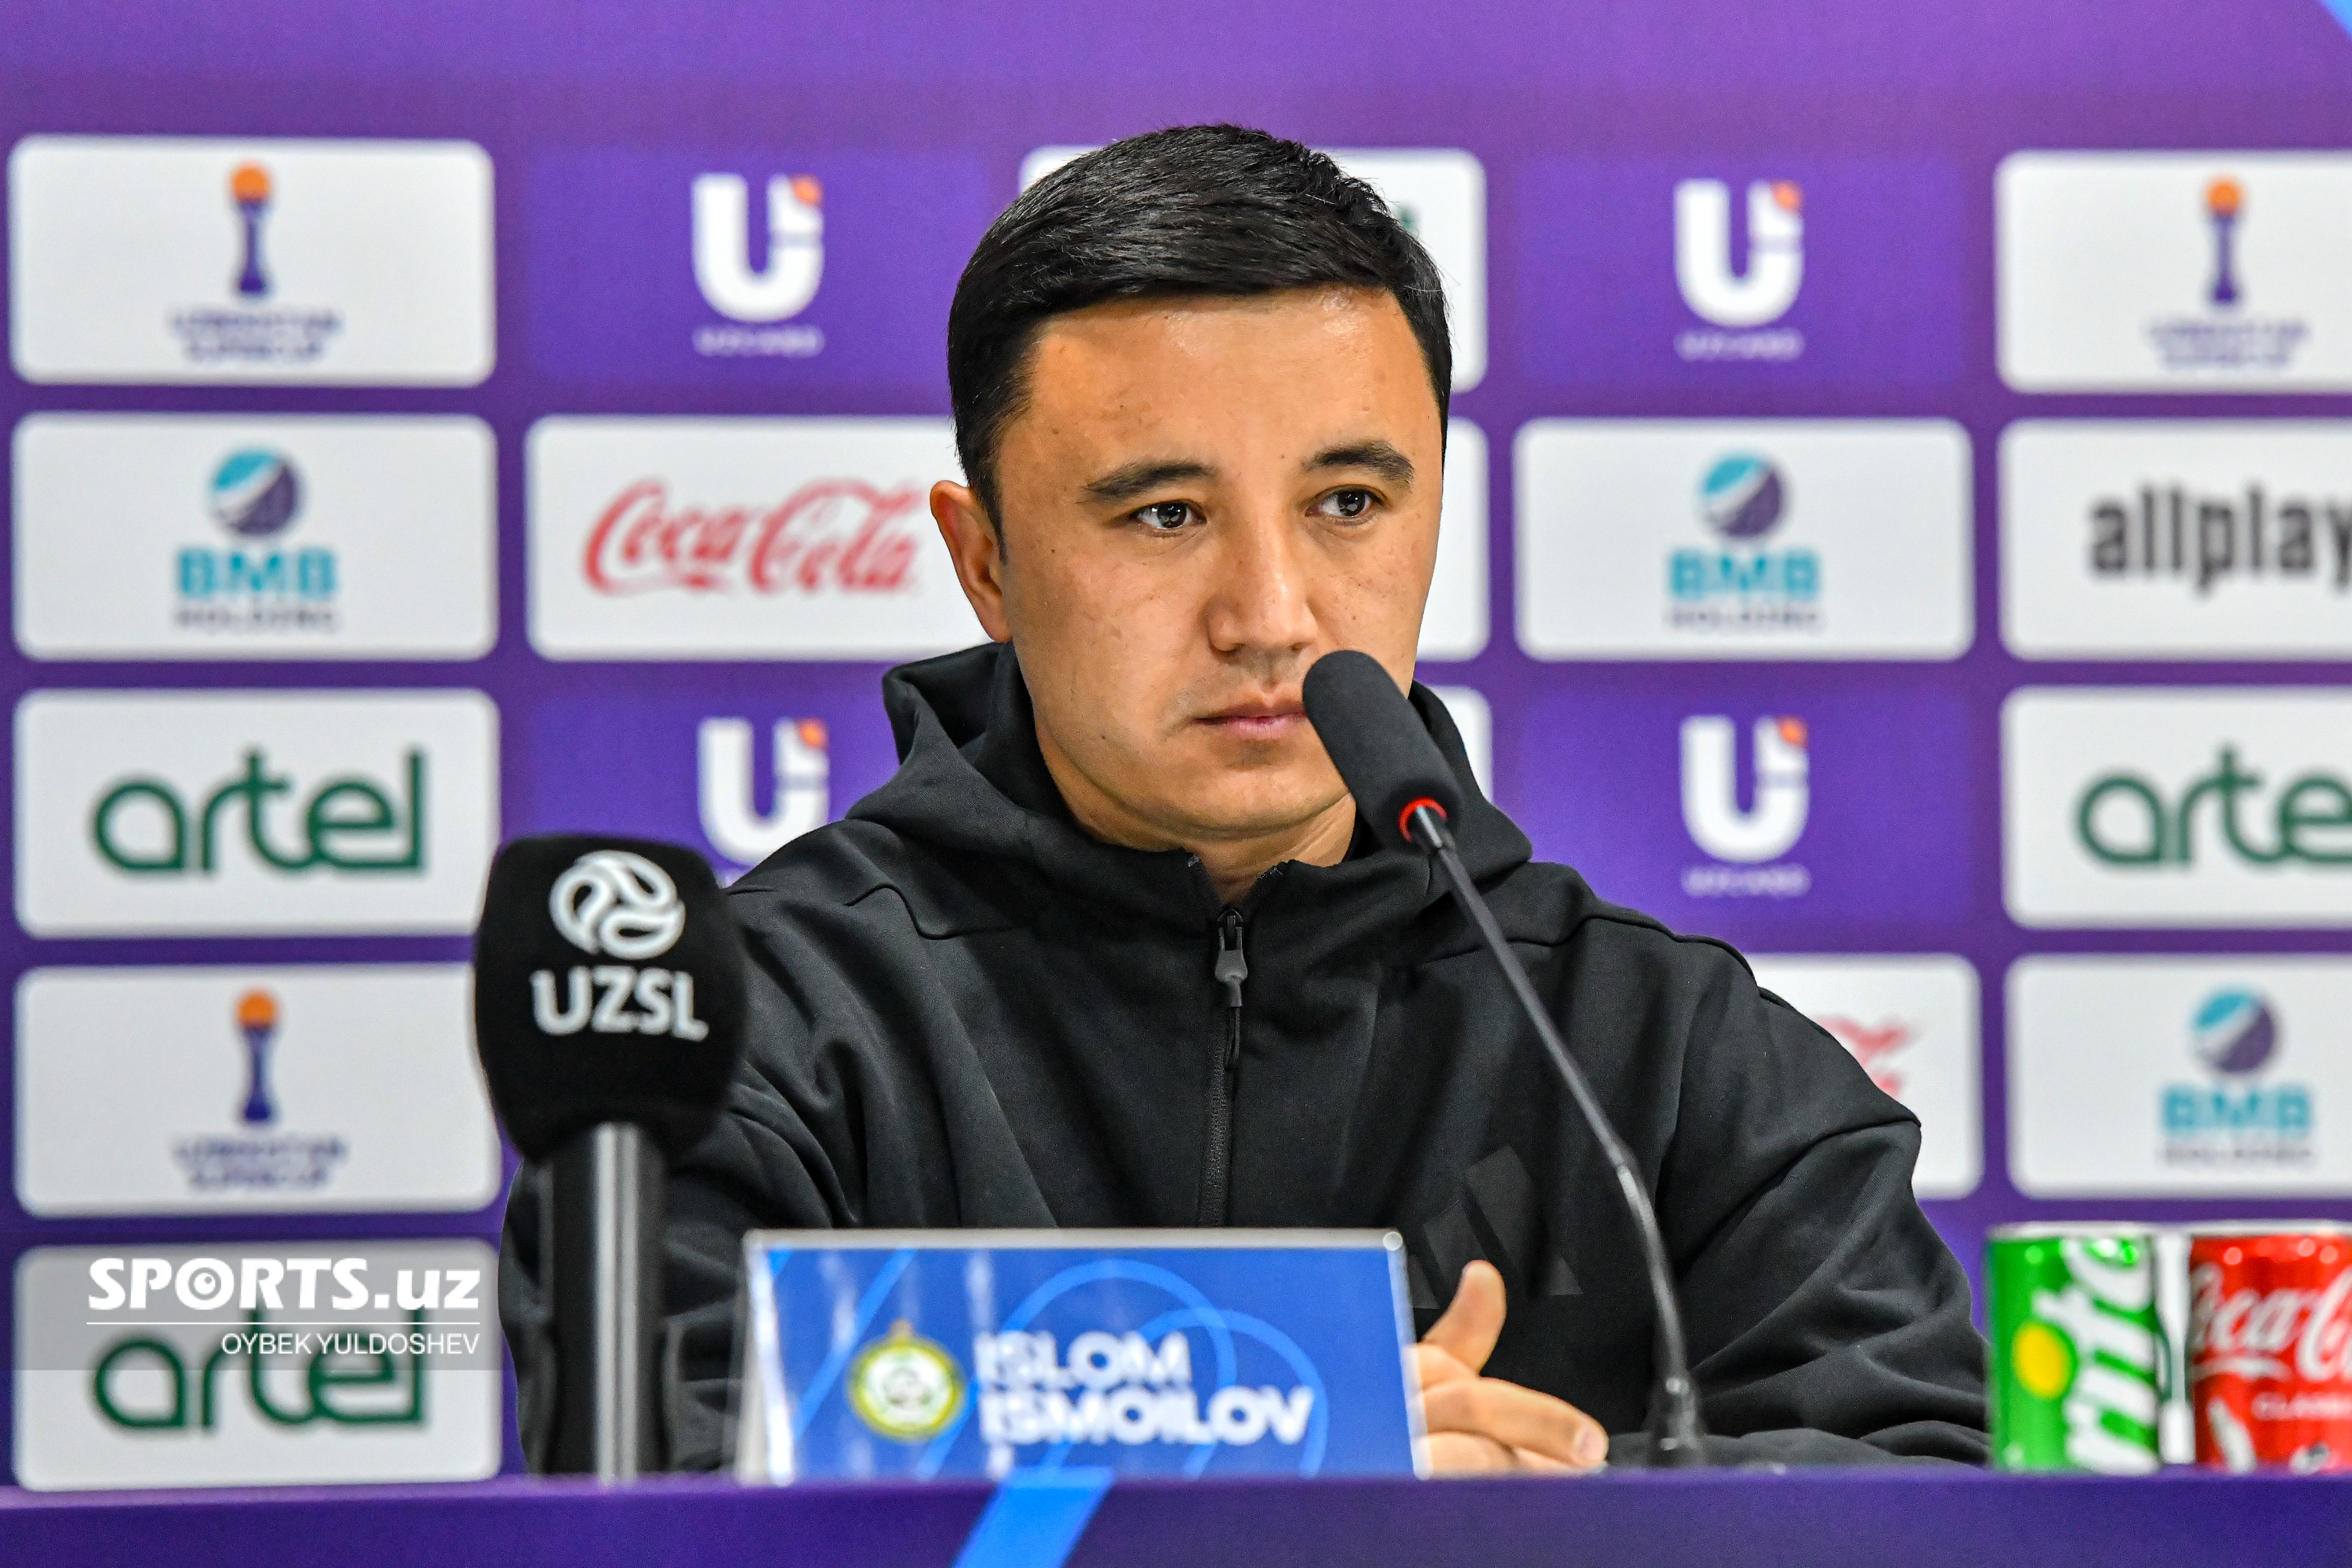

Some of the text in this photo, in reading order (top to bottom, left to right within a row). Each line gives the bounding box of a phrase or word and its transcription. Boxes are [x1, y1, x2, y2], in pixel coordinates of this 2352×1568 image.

[176, 546, 338, 598] BMB
[92, 746, 426, 874] artel
[529, 965, 709, 1041] UZSL
[95, 1296, 427, 1430] artel
[974, 1331, 1191, 1388] ISLOM
[980, 1385, 1313, 1445] ISMOILOV
